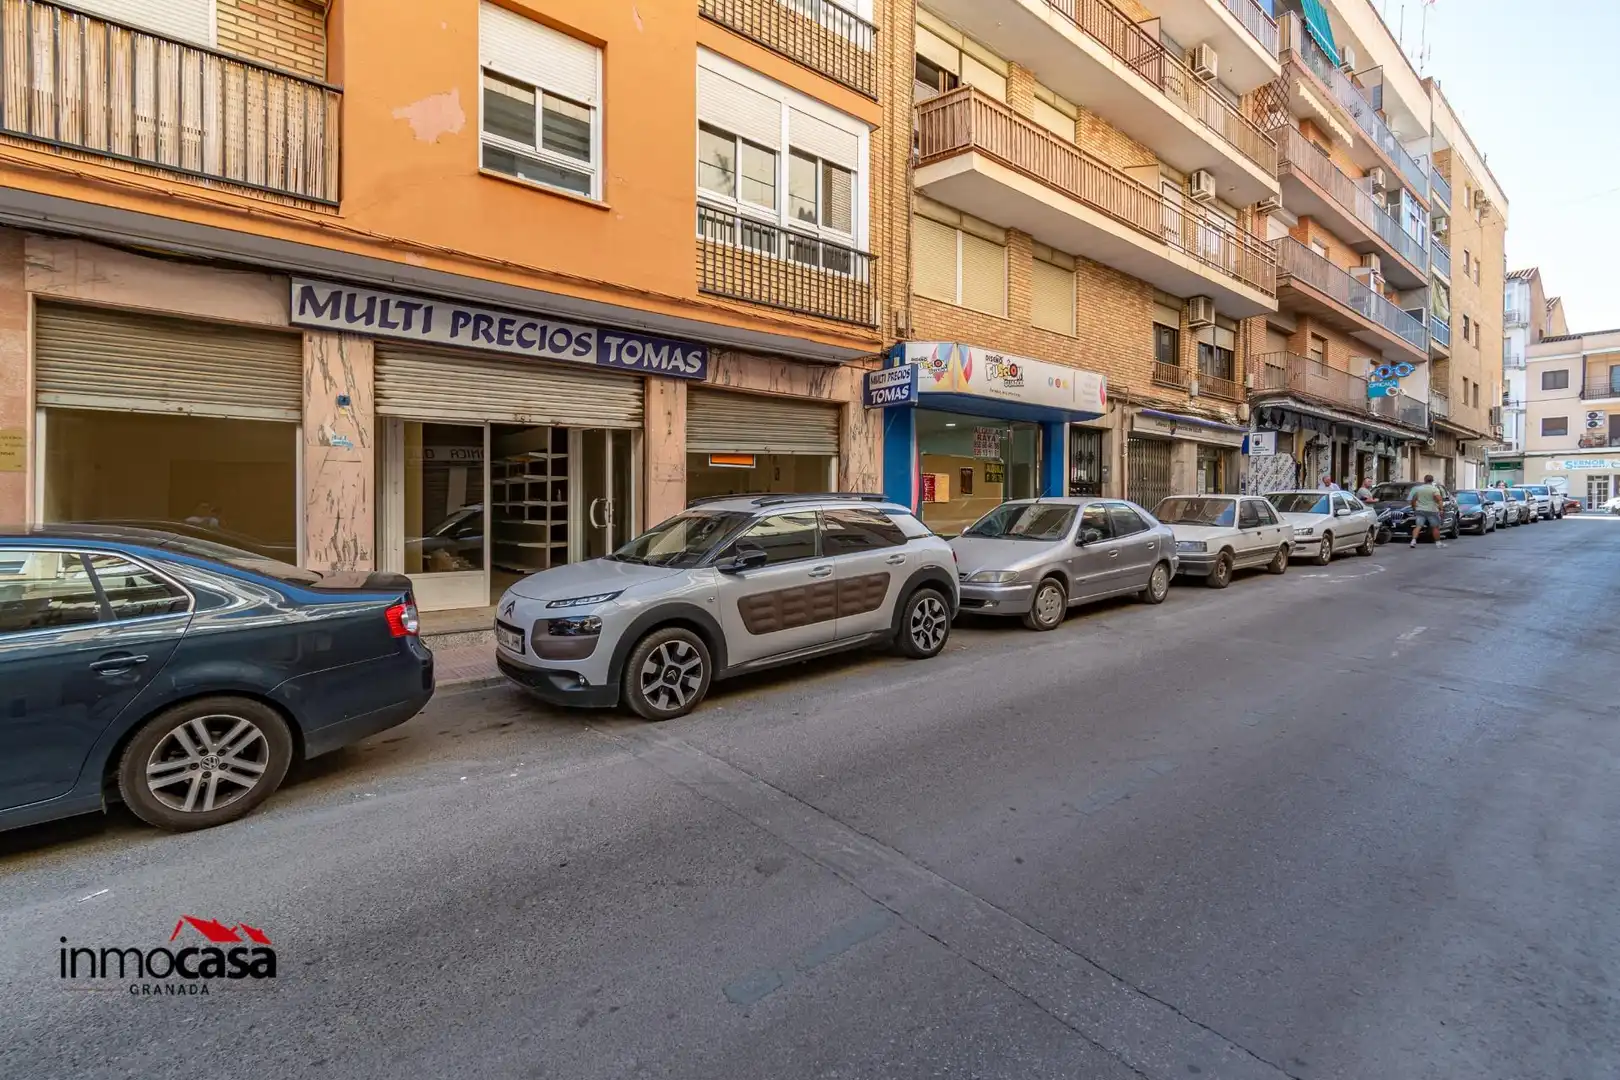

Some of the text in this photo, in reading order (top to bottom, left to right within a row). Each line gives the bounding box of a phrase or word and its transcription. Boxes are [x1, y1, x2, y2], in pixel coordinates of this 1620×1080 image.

[298, 285, 701, 374] MULTI PRECIOS TOMAS
[870, 368, 910, 385] MULTI PRECIOS
[871, 385, 910, 404] TOMAS
